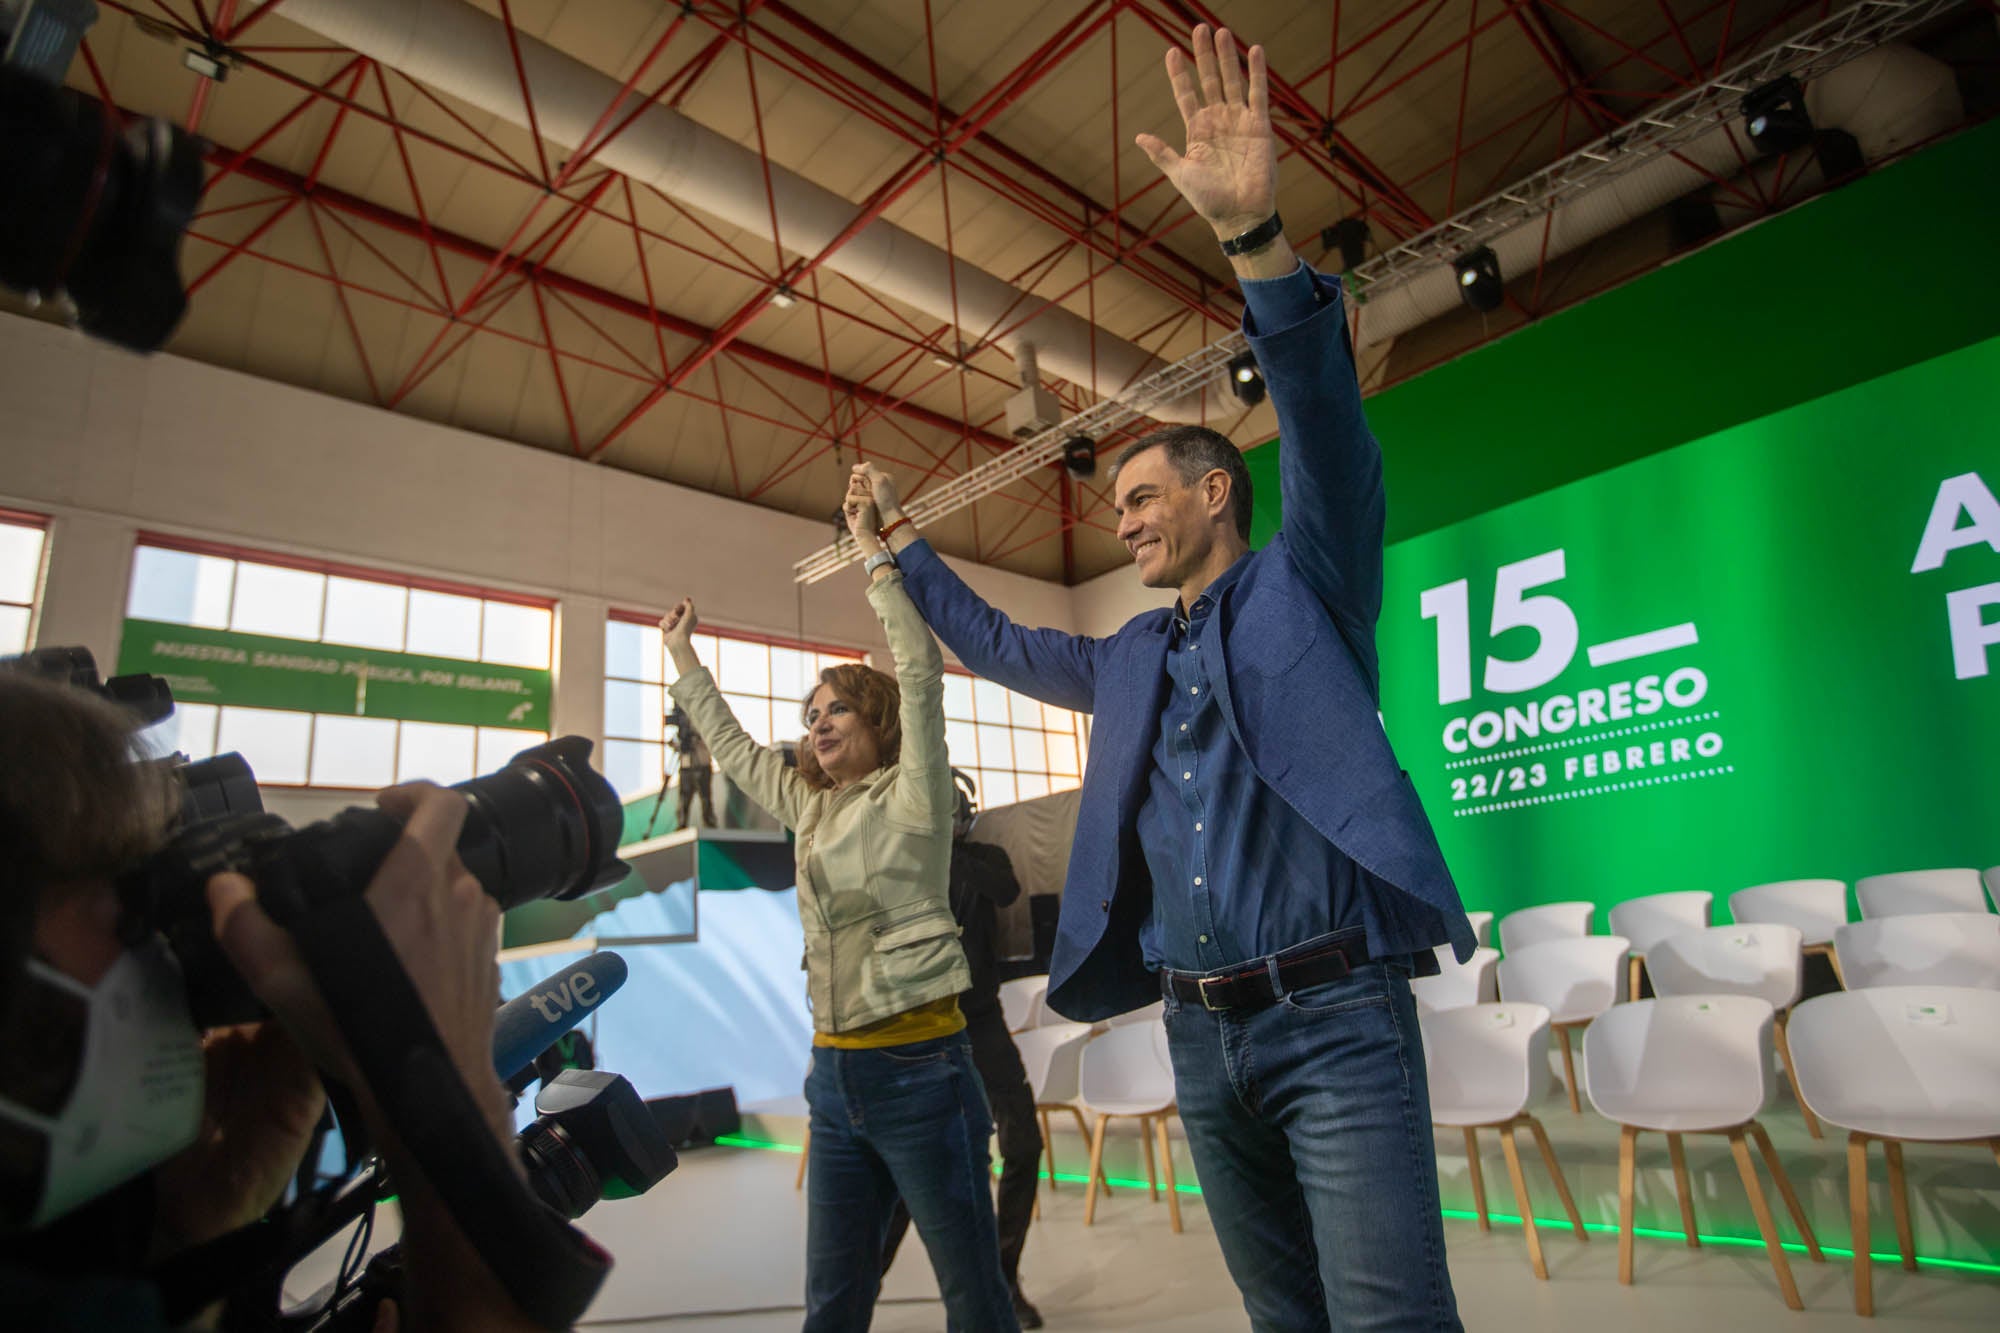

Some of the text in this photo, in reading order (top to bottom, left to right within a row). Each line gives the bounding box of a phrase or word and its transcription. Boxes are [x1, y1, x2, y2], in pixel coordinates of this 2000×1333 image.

[1442, 667, 1708, 753] CONGRESO
[1451, 732, 1723, 801] 22/23 FEBRERO
[529, 972, 600, 1023] tve
